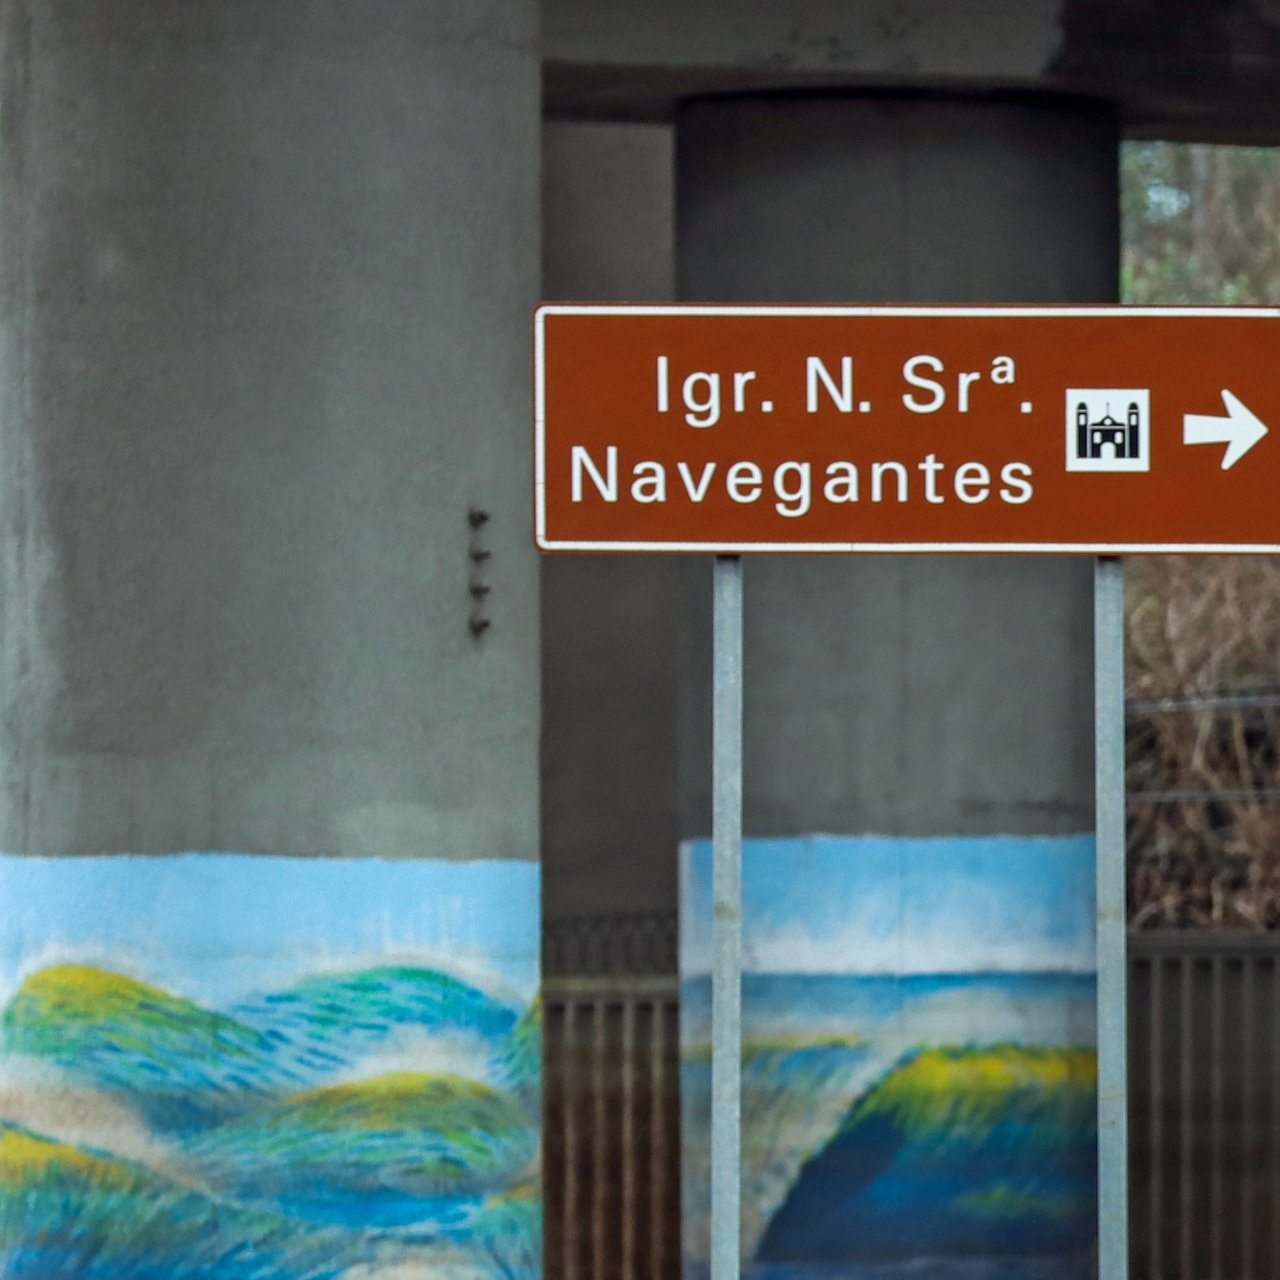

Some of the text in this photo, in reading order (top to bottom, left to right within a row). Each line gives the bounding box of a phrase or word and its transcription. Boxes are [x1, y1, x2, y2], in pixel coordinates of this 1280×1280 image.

[657, 355, 774, 428] Igr.
[806, 356, 871, 414] N.
[571, 445, 1034, 519] Navegantes
